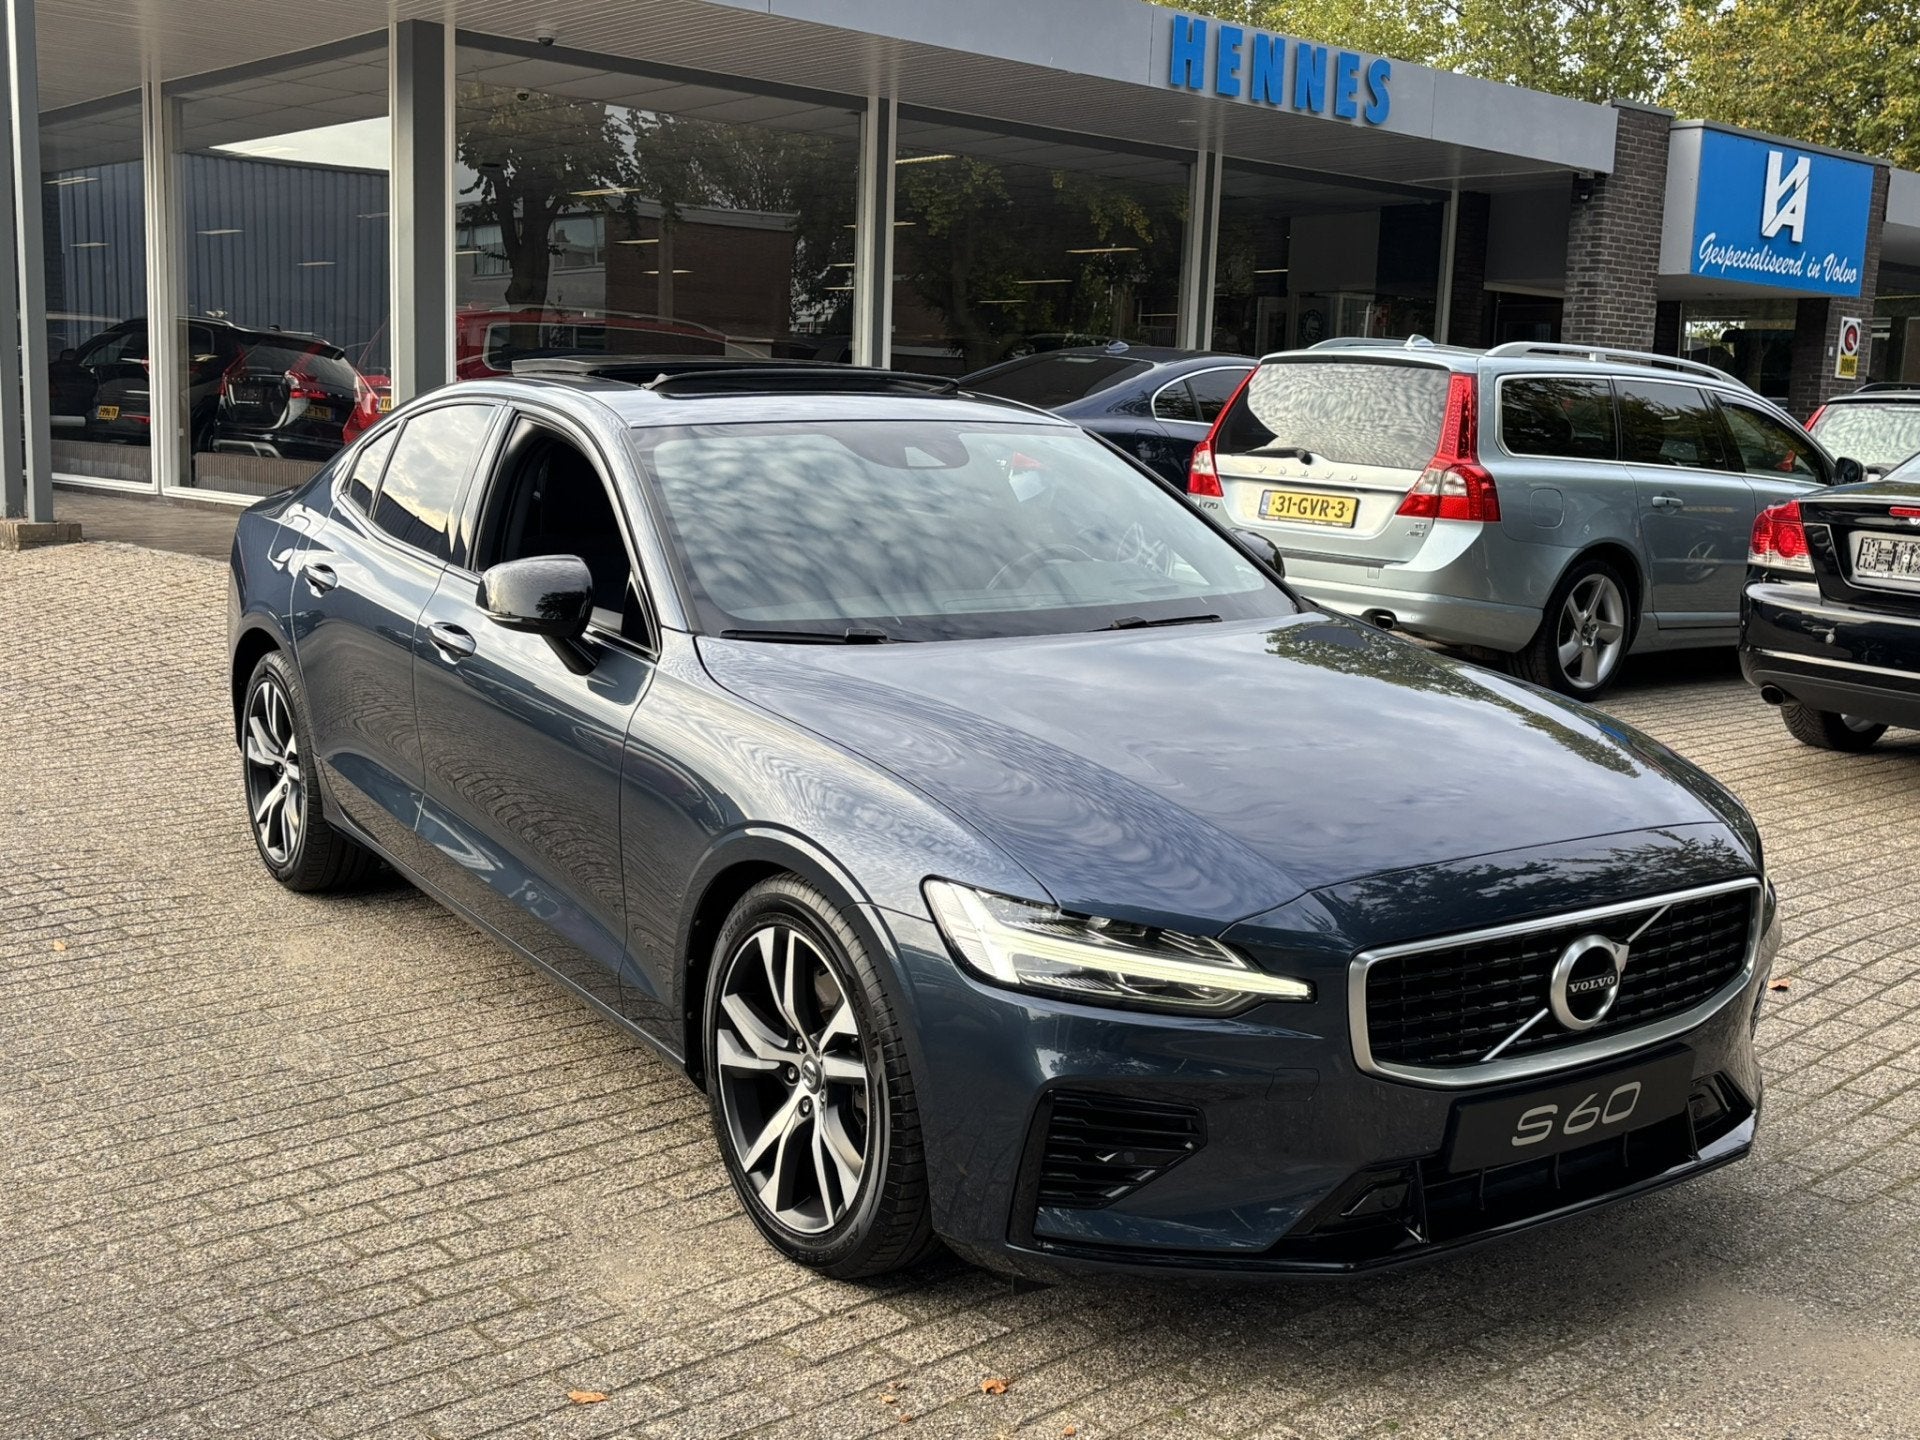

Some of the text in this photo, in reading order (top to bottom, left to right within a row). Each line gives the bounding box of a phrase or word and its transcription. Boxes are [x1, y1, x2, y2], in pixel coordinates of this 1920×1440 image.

[1170, 14, 1391, 125] HENNES
[1699, 232, 1857, 283] Gespecialiseerd in Volvo
[1275, 495, 1347, 519] 31-GVR-3
[1568, 975, 1615, 993] VOLVO
